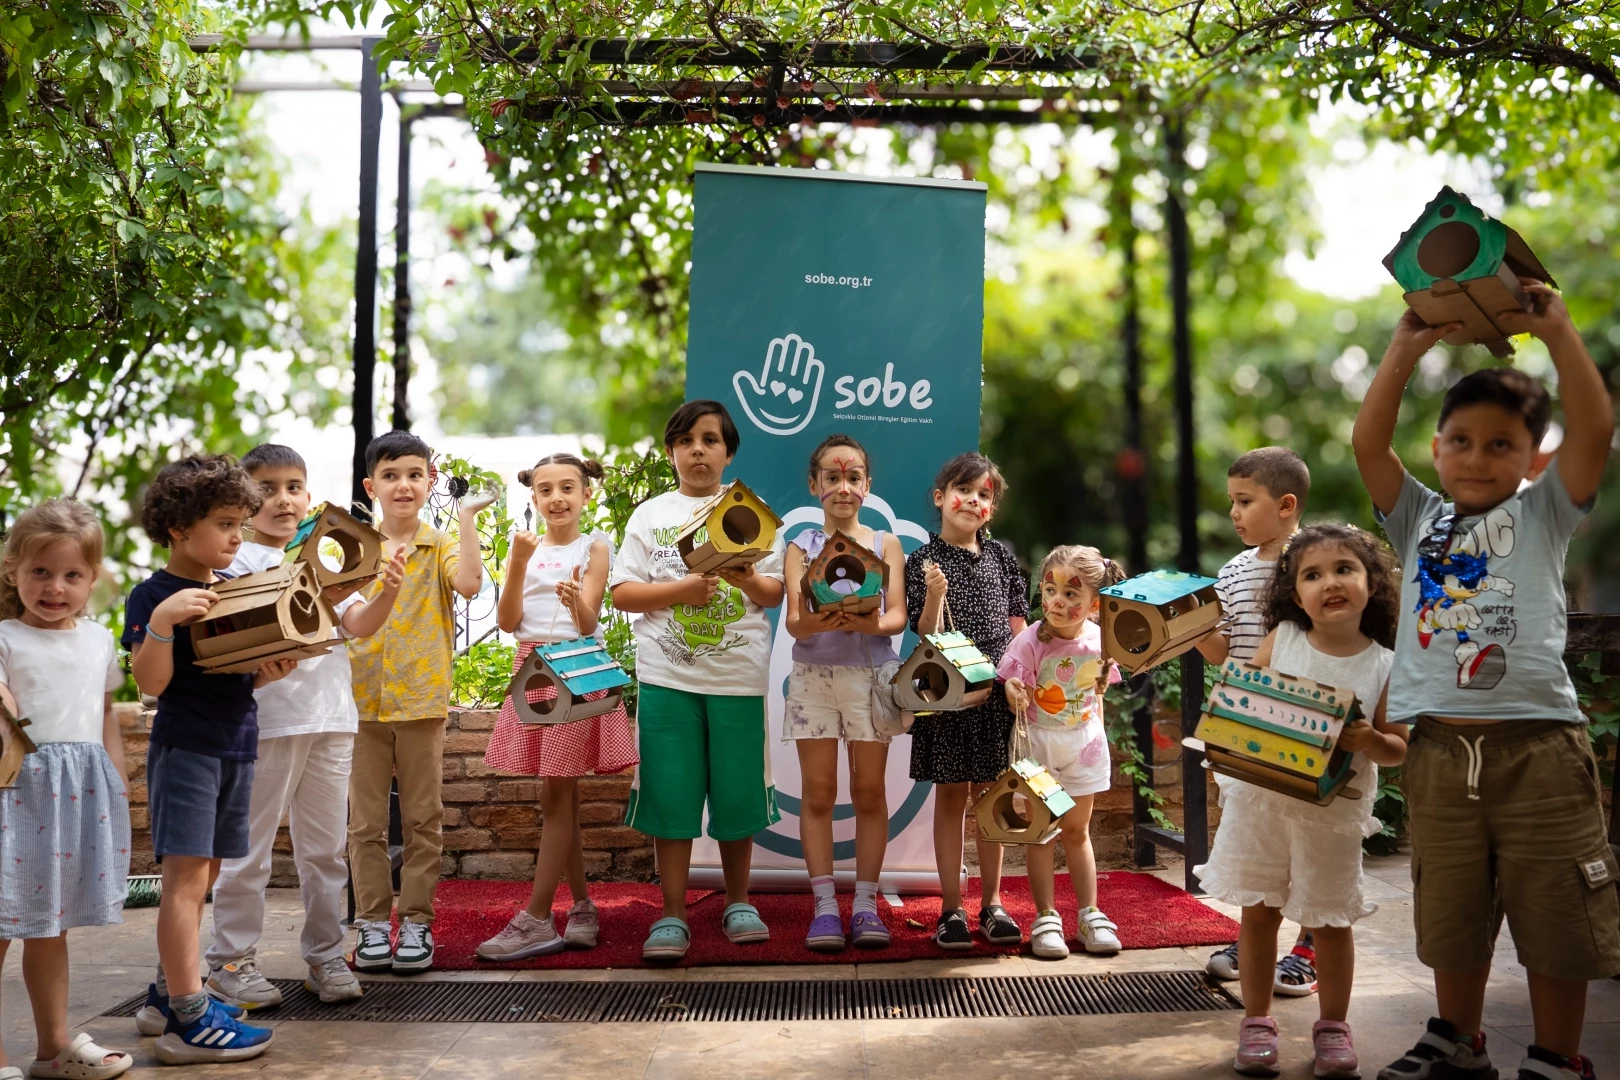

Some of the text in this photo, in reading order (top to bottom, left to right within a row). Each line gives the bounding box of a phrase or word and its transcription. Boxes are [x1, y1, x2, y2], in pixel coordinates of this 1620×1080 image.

[804, 273, 873, 288] sobe.org.tr
[834, 362, 933, 410] sobe
[682, 602, 737, 621] OF THE
[690, 622, 718, 637] DAY
[1483, 626, 1513, 637] FAST
